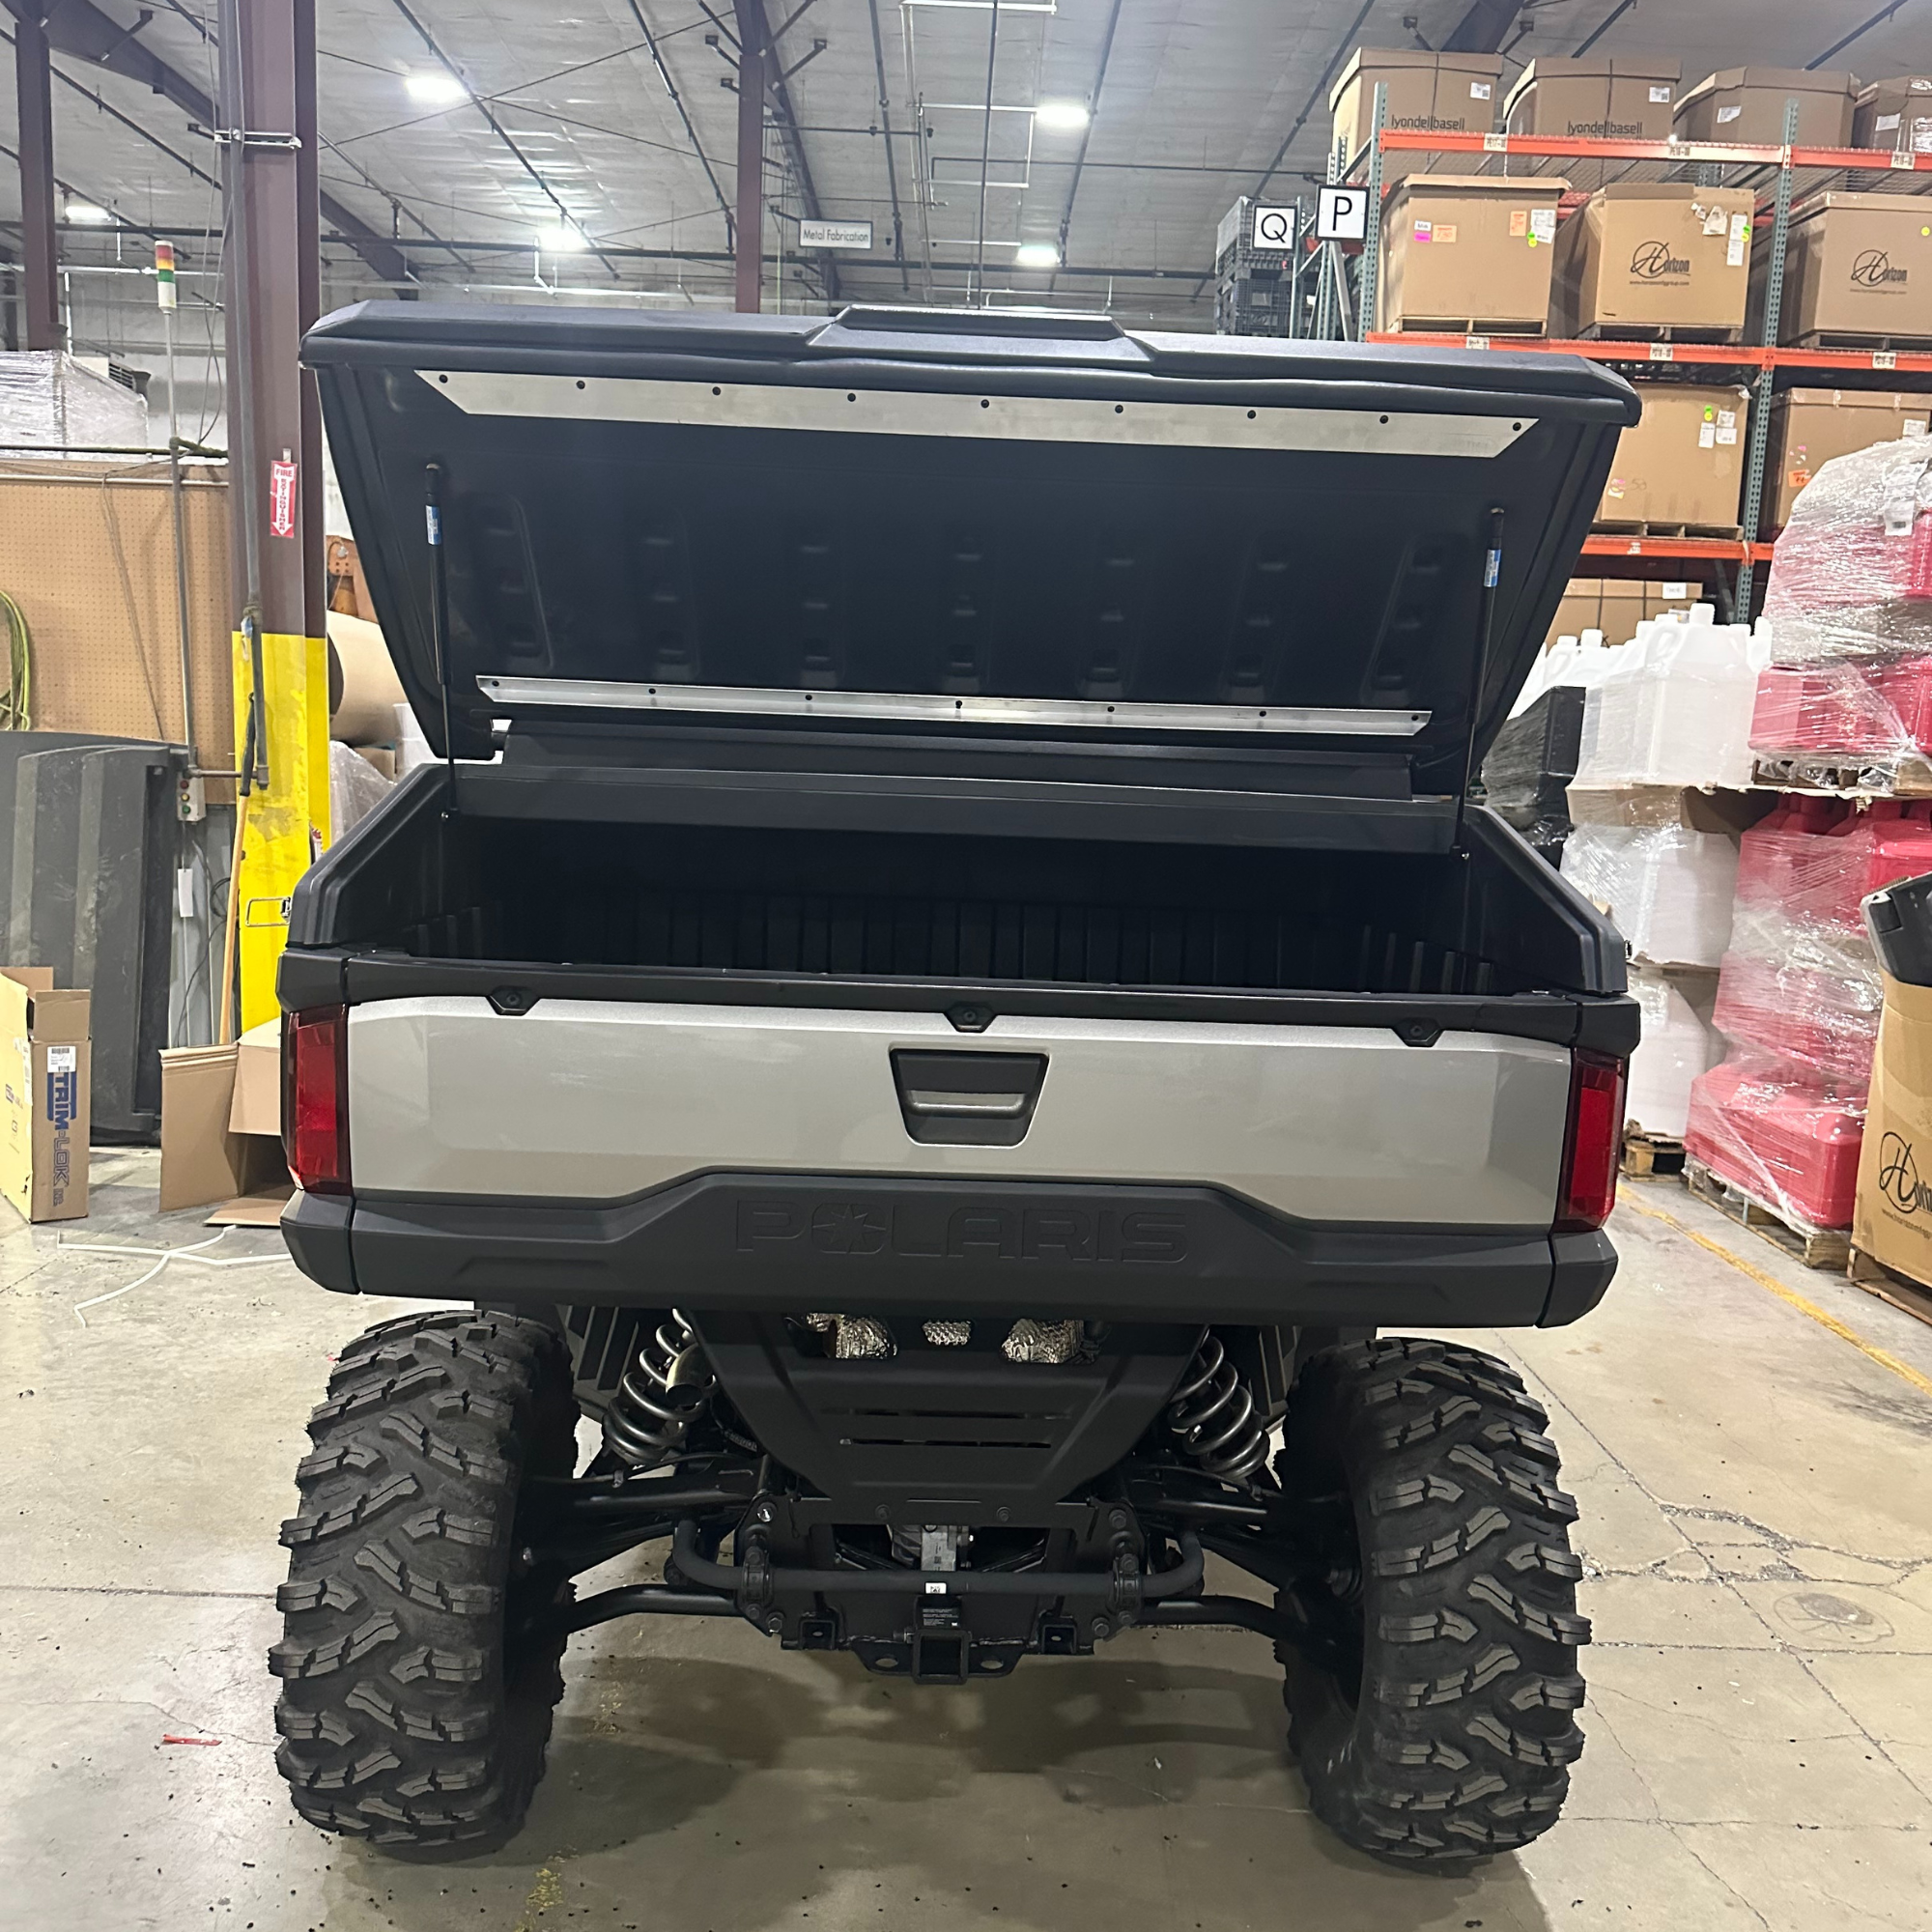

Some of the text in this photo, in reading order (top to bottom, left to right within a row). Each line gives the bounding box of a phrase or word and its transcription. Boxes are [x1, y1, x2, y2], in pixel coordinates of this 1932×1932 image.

[1391, 115, 1465, 130] lyondellbasell
[1567, 121, 1643, 136] lyondellbasell
[1261, 213, 1288, 243] Q
[1332, 196, 1353, 231] P
[803, 228, 869, 242] Metal Fabrication
[1630, 241, 1690, 278] Horizon
[1851, 249, 1908, 287] Horizon
[275, 469, 293, 477] FIRE
[736, 1199, 1189, 1264] POLARIS
